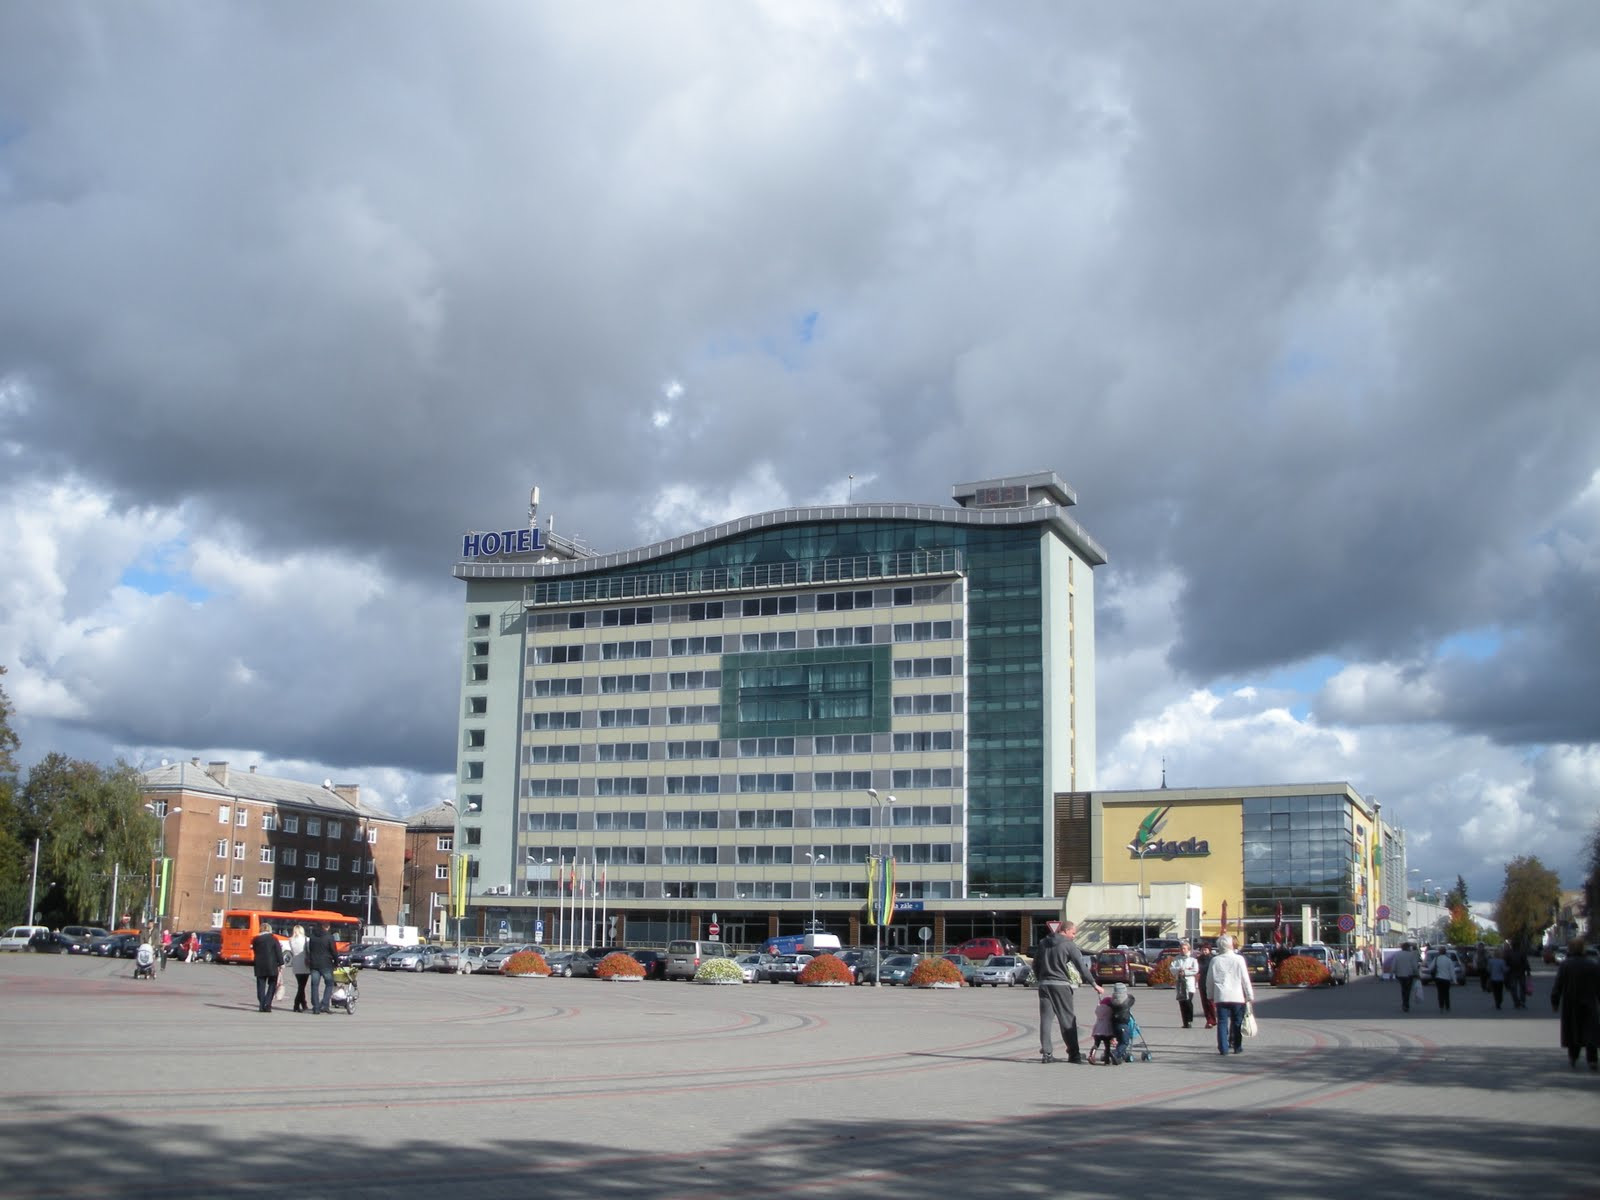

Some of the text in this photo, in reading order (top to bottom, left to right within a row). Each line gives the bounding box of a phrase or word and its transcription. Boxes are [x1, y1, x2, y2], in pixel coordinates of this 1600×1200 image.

[463, 528, 544, 557] HOTEL
[501, 920, 507, 928] P
[537, 922, 542, 930] P
